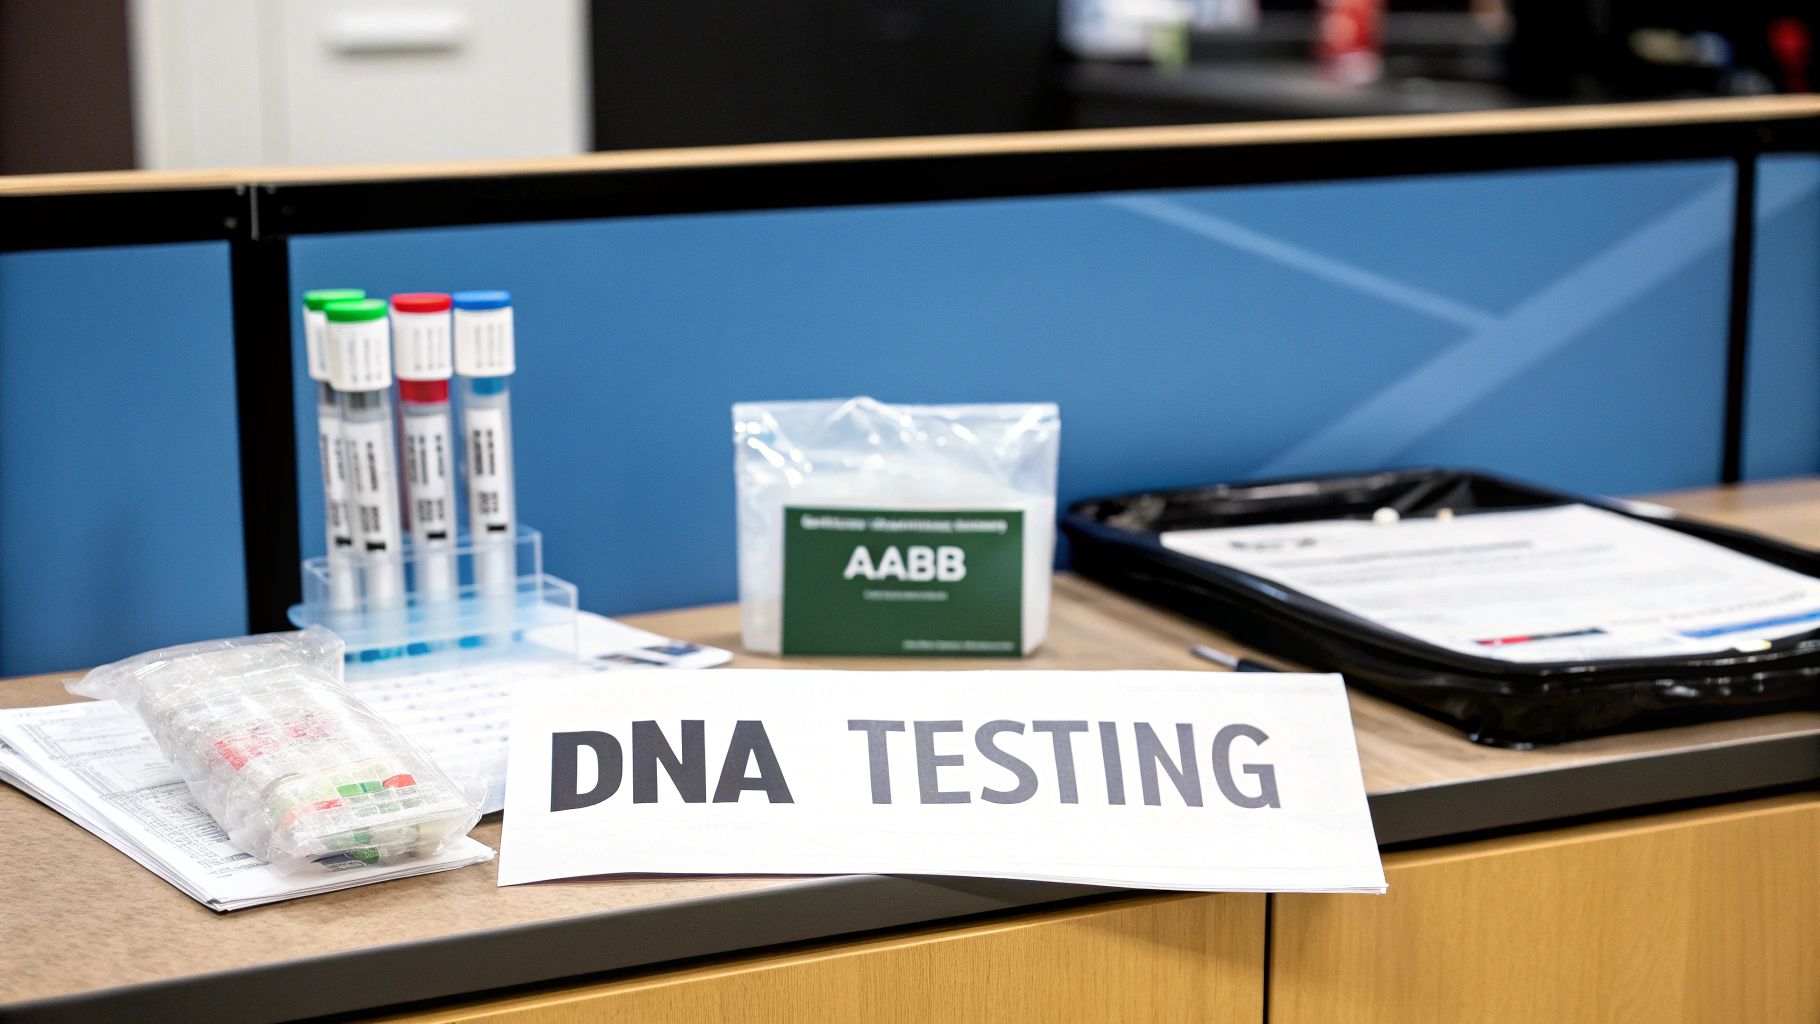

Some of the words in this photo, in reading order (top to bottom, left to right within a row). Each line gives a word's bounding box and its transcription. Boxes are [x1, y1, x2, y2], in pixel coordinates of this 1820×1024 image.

[844, 545, 967, 582] AABB
[550, 720, 794, 812] DNA
[848, 720, 1281, 808] TESTING
